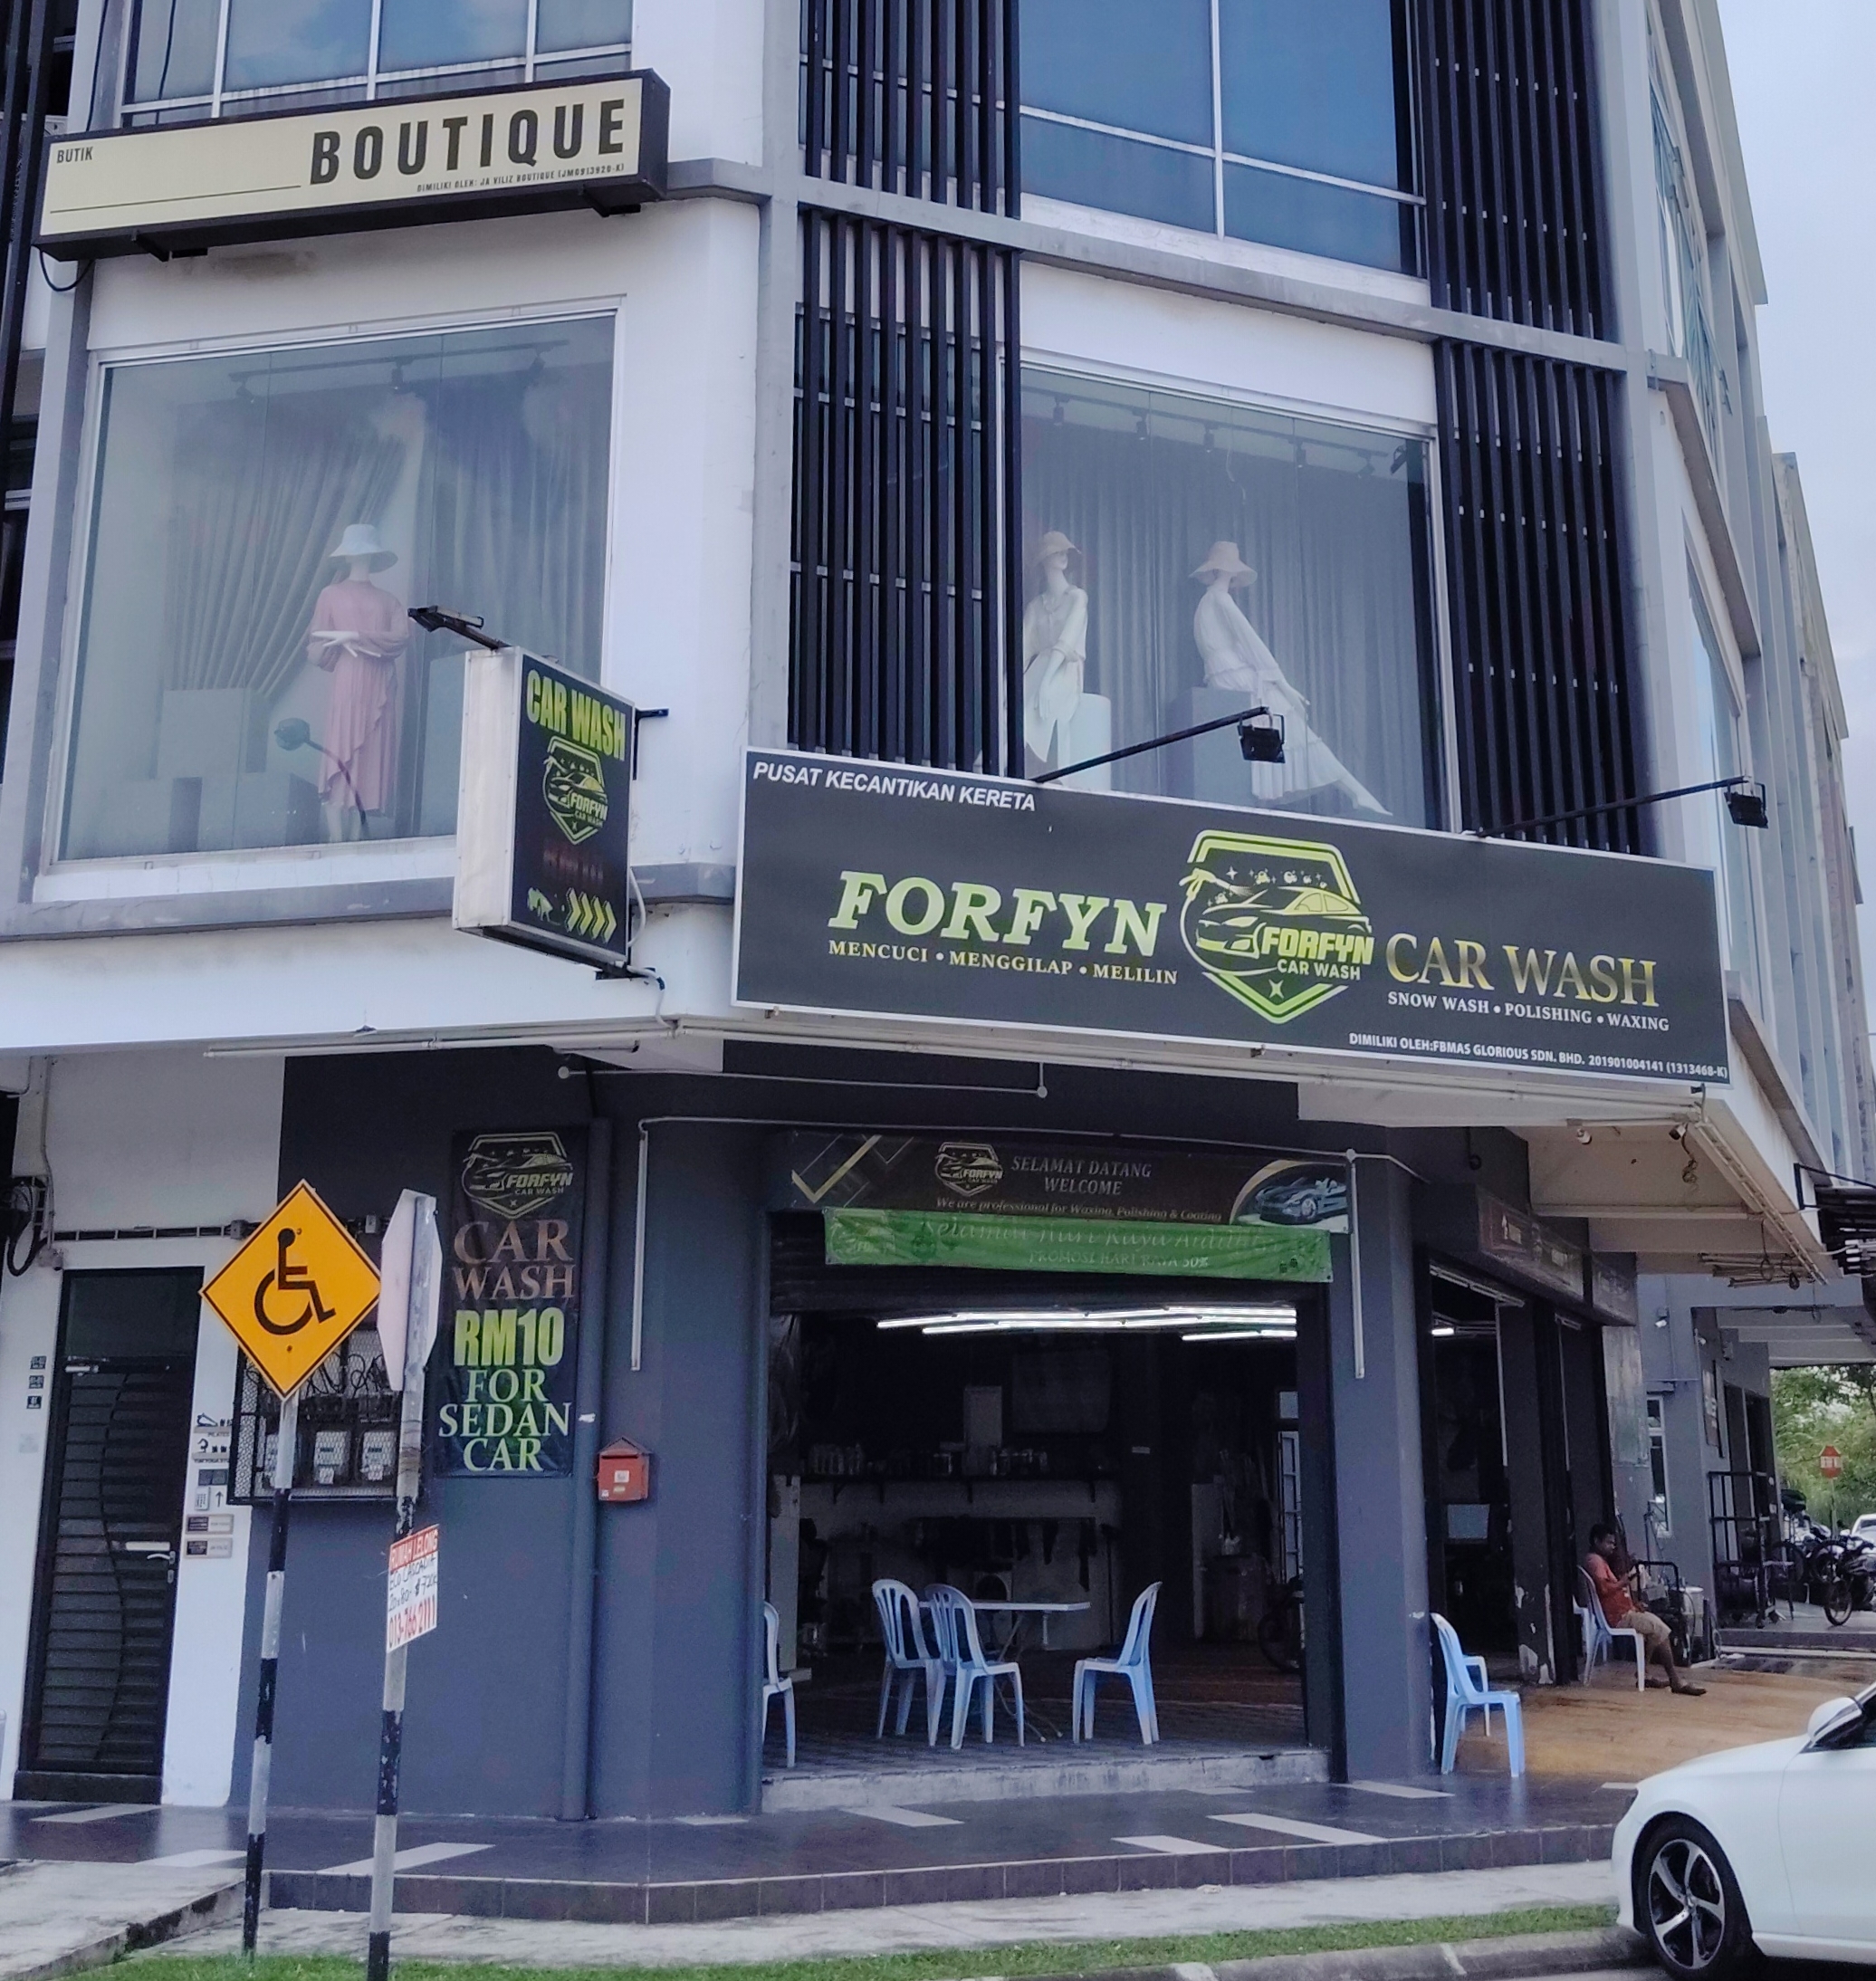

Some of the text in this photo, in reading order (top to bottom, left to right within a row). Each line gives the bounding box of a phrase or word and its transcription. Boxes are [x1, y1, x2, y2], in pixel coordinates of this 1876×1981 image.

[56, 147, 94, 164] BUTIK
[310, 99, 626, 185] BOUTIQUE
[417, 180, 452, 193] DIMILIKI
[455, 179, 477, 189] OLEH:
[480, 177, 490, 187] JA
[493, 175, 513, 186] VILIZ
[516, 170, 555, 183] BOUTIQUE
[526, 669, 626, 761] CAR WASH
[753, 761, 1036, 812] PUSAT KECANTIKAN KERETA
[570, 792, 608, 821] FORFYN
[828, 871, 1661, 1008] FORFYN CAR WASH
[1259, 926, 1375, 966] FORFYN
[828, 939, 1178, 985] MENCUCI MENGGILAP MELILIN
[1277, 958, 1362, 981] CAR WASH
[1387, 990, 1670, 1032] SNOW WASH POLISHING WAXING
[1349, 1032, 1397, 1048] DIMILIKI
[1473, 1044, 1530, 1061] GLORIOUS
[1530, 1048, 1557, 1064] SDN.
[1558, 1050, 1585, 1067] BHD.
[1588, 1055, 1665, 1074] 201901004141
[1666, 1060, 1728, 1079] (1313468-K)
[506, 1172, 574, 1188] FORFYN
[1011, 1155, 1153, 1178] SELAMAT DATANG
[536, 1187, 564, 1195] WASH
[1044, 1177, 1123, 1196] WELCOME
[936, 1197, 953, 1209] We
[956, 1201, 976, 1210] are
[979, 1198, 1049, 1213] professional
[1050, 1202, 1067, 1214] for
[1117, 1205, 1168, 1220] Polishing
[1170, 1210, 1178, 1219] &
[1181, 1211, 1222, 1223] Coating
[454, 1219, 575, 1265] CAR
[1029, 1249, 1096, 1264] PROMOSI
[1100, 1251, 1136, 1265] HARI
[454, 1264, 576, 1301] WASH
[454, 1306, 565, 1367] RM10
[464, 1368, 550, 1403] FOR
[438, 1402, 573, 1438] SEDAN
[463, 1437, 543, 1472] CAR
